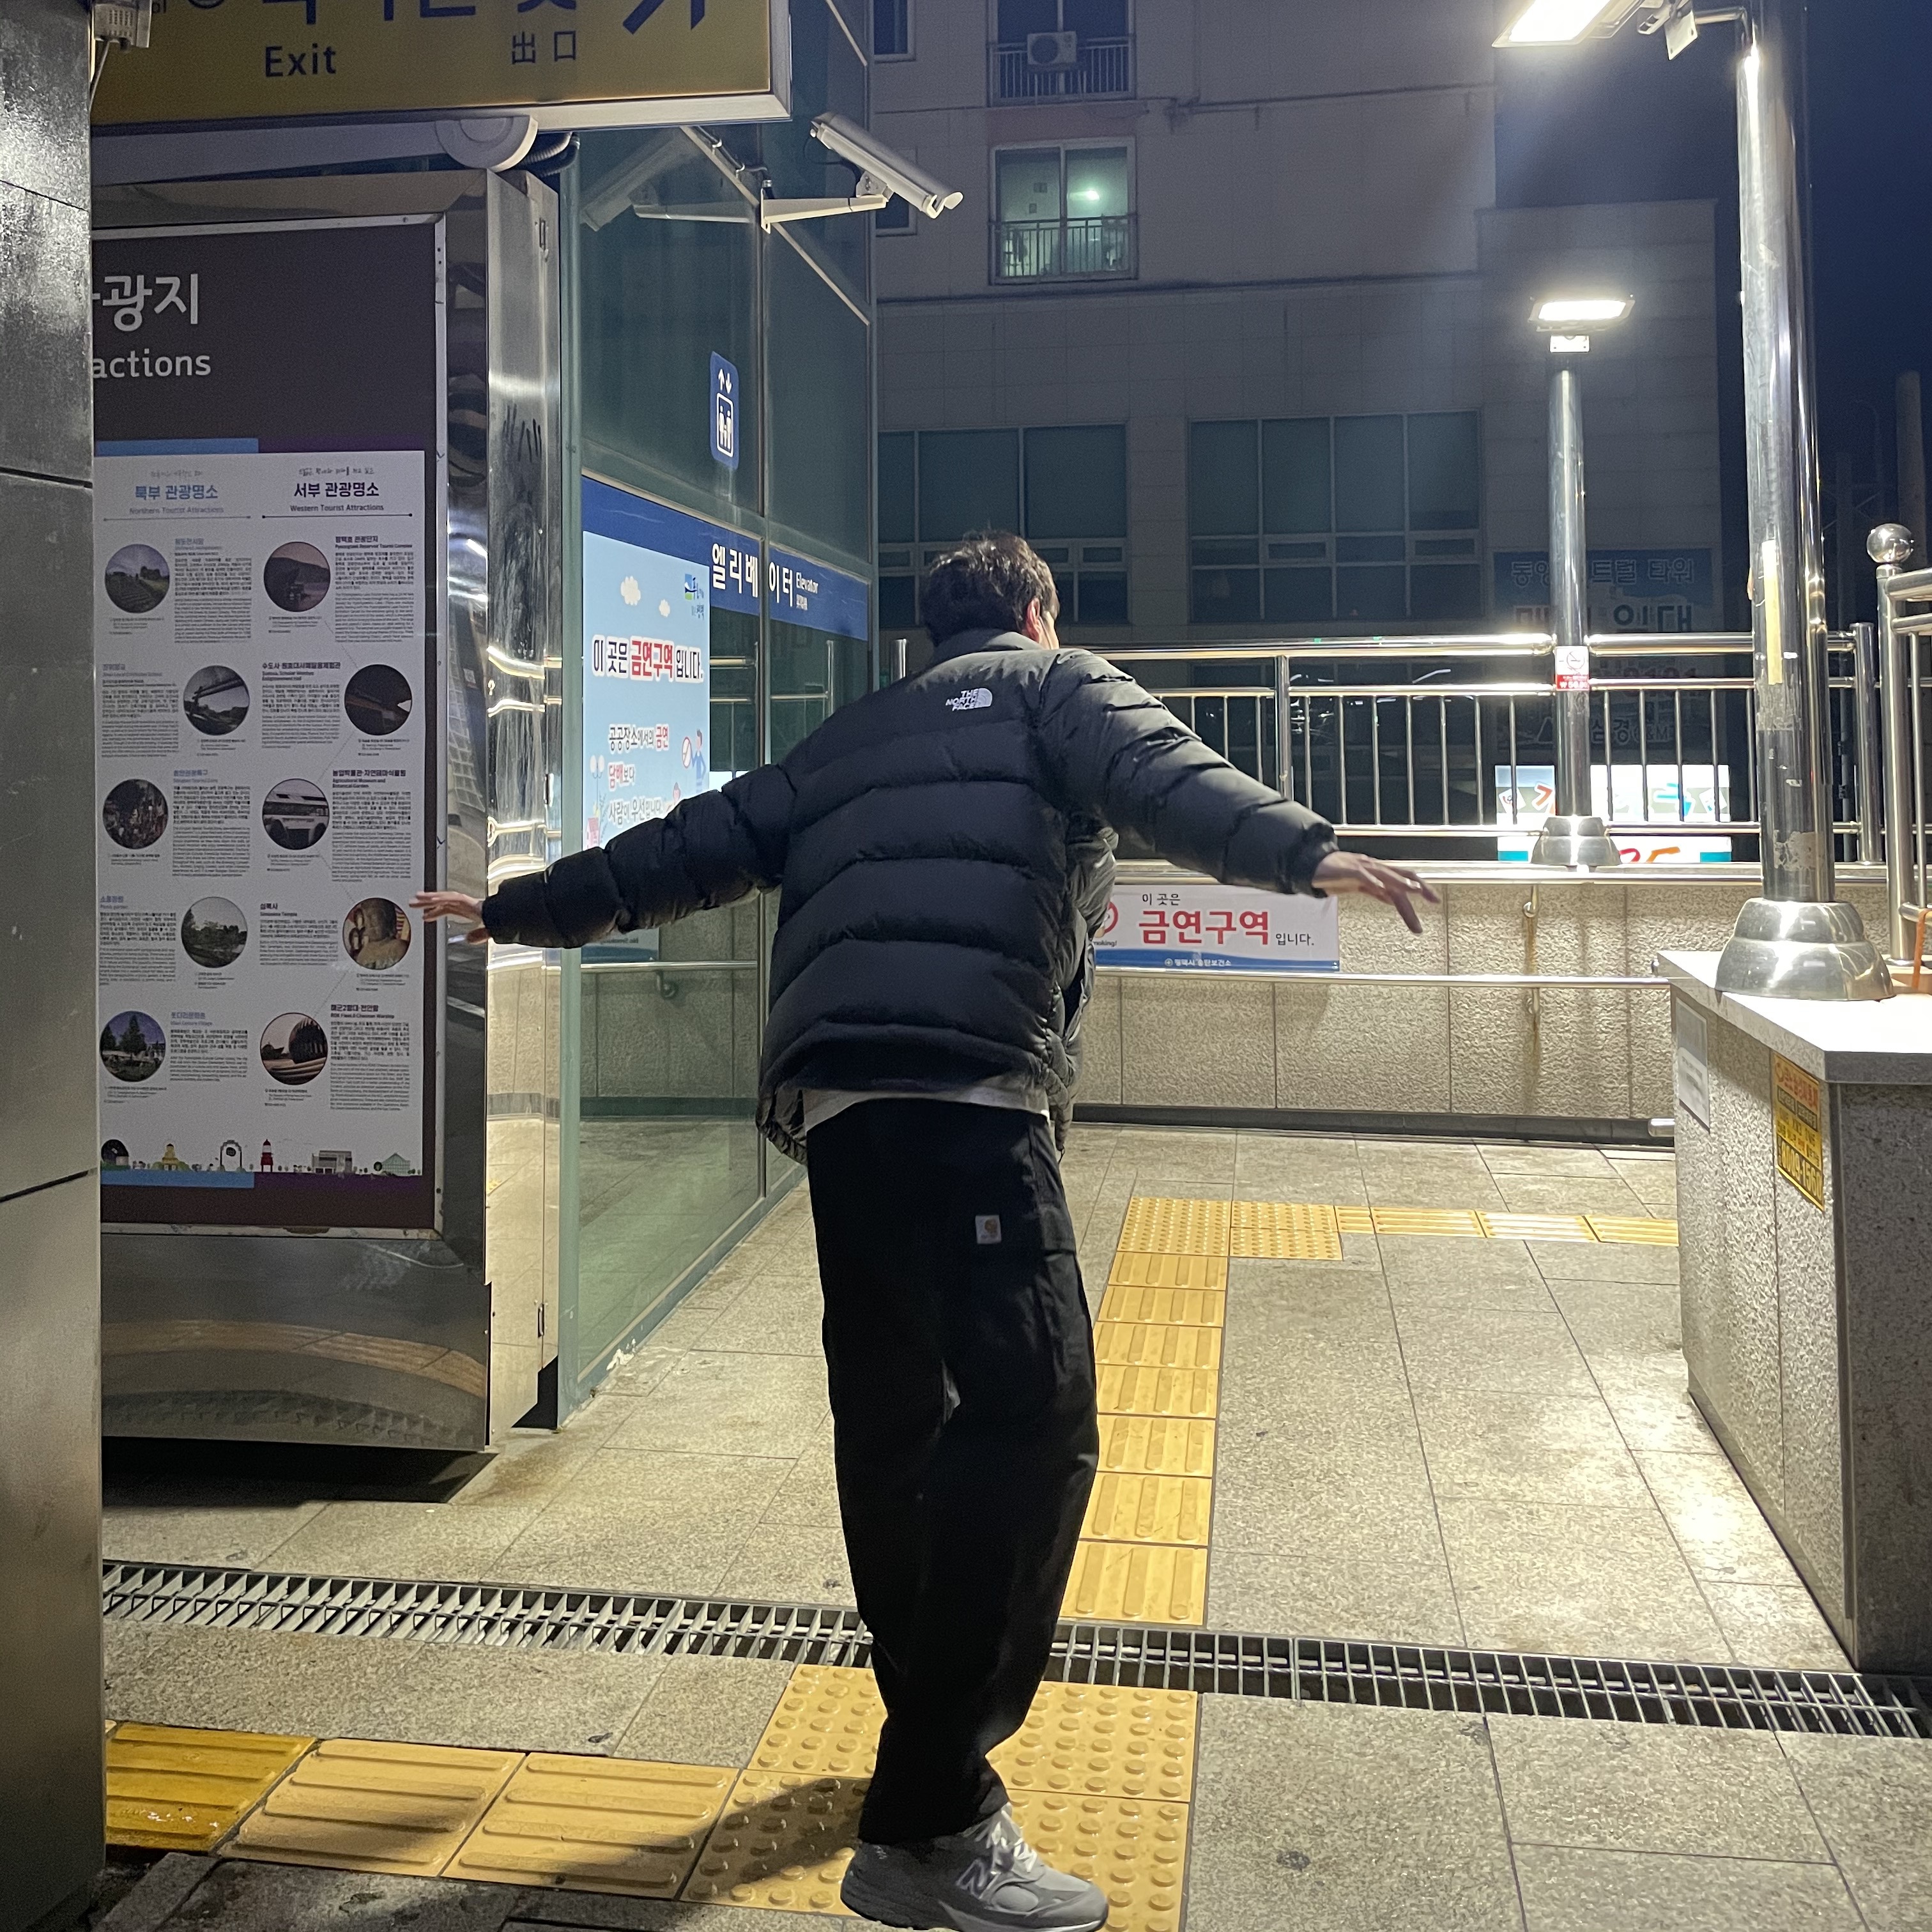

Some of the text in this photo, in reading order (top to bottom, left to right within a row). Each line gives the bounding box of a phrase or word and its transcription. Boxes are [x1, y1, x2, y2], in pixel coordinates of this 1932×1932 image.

[265, 43, 336, 77] Exit
[512, 31, 576, 64] 出口
[93, 273, 198, 332] 광지
[93, 349, 211, 378] actions
[135, 484, 218, 500] 북부 관광명소
[294, 482, 379, 498] 서부 관광명소
[712, 543, 793, 607] 엘리베이터
[1647, 556, 1694, 584] 타워
[796, 572, 818, 594] Elevator
[594, 640, 703, 679] 이 곳은 금연구역 입니다.
[946, 695, 977, 706] NORTH
[961, 688, 979, 698] THE
[609, 726, 668, 751] 공공장소에서의 금연
[609, 765, 635, 789] 담배보다
[609, 802, 629, 825] 사람이
[1142, 893, 1181, 906] 이 곳은
[1138, 910, 1315, 947] 금연구역 입니다.
